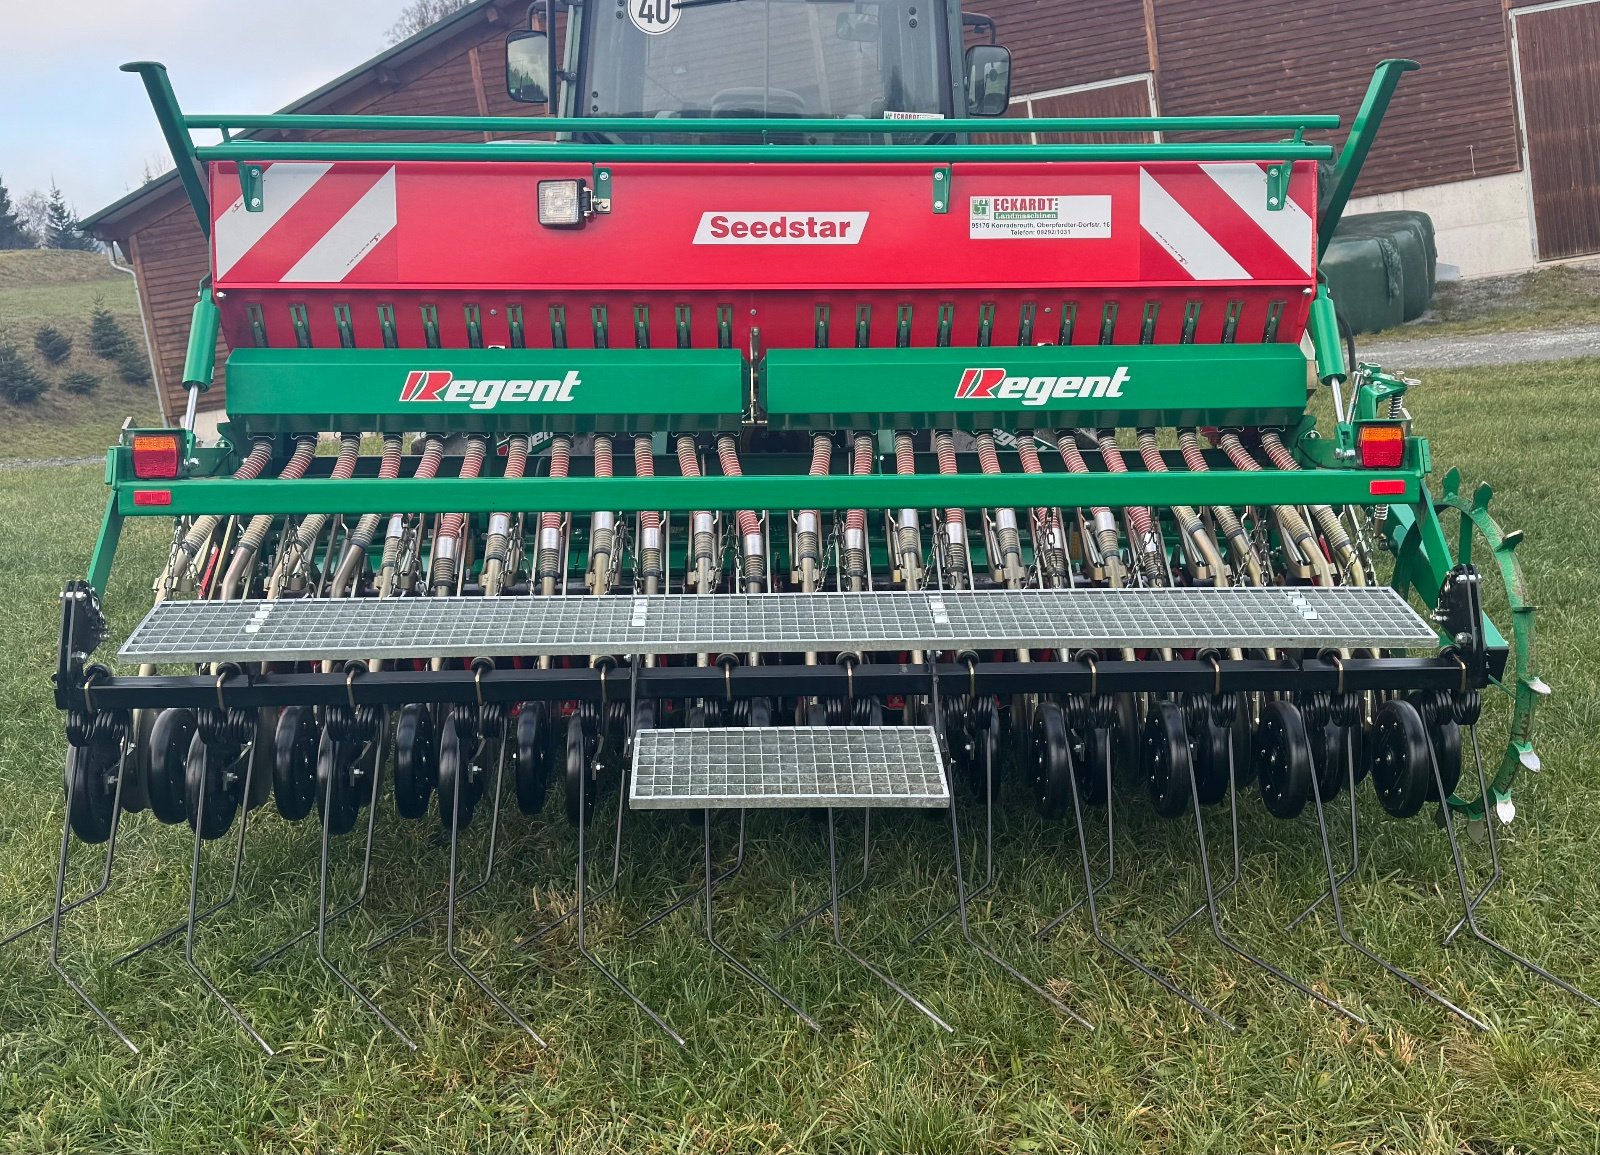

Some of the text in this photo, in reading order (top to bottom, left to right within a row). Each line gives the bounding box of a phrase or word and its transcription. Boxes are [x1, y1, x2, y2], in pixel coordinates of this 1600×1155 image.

[638, 0, 670, 24] 40
[993, 198, 1055, 212] ECKARDT
[995, 212, 1057, 220] Landmaschinen
[710, 215, 851, 239] Seedstar
[399, 370, 582, 410] Regent
[954, 366, 1131, 406] Regent
